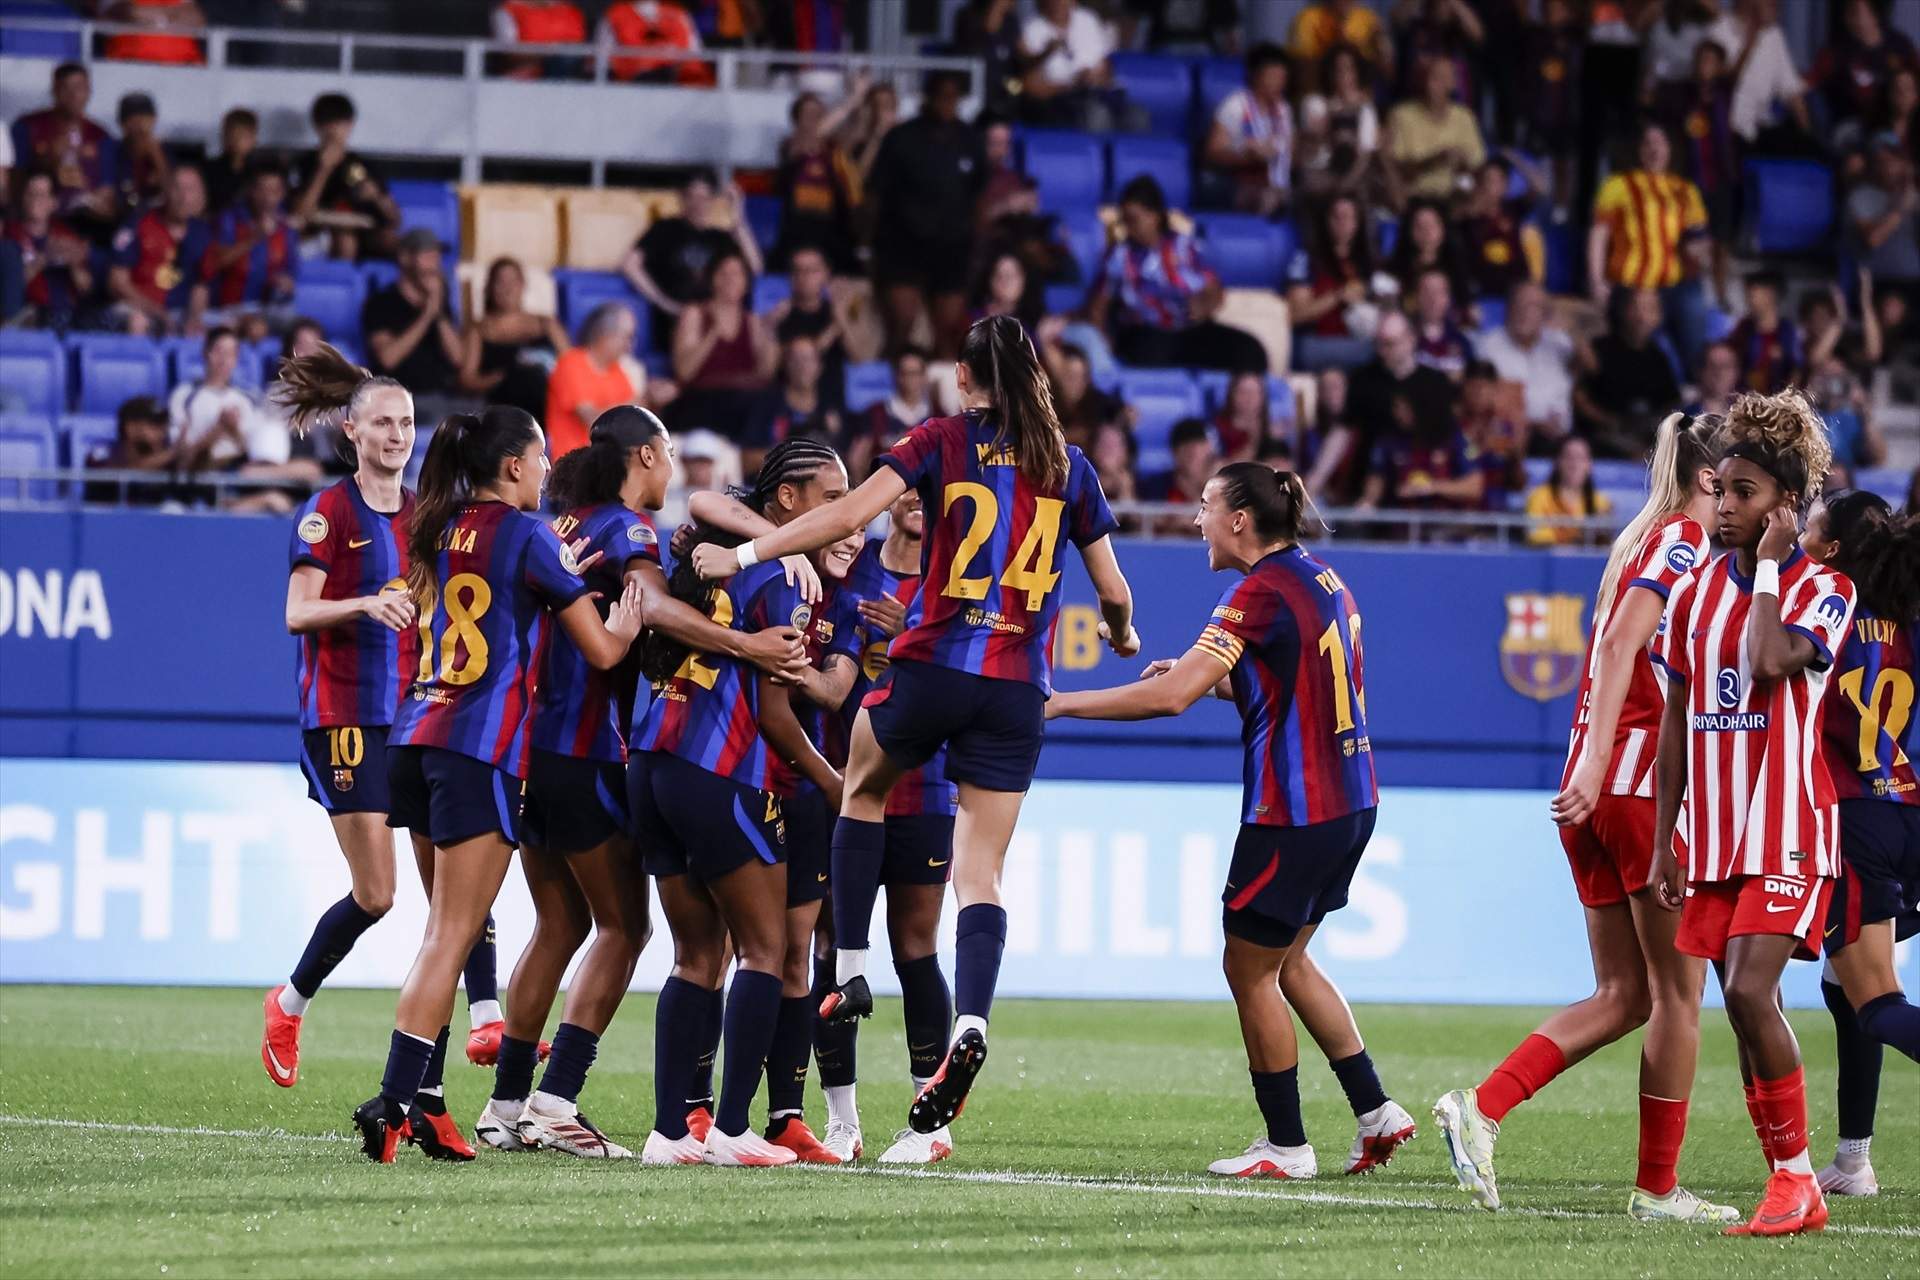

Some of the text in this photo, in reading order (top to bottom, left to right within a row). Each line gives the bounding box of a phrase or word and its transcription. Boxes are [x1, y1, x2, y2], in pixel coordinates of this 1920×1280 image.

[941, 481, 1066, 612] 24
[416, 572, 492, 686] 18
[326, 727, 364, 768] 10
[0, 803, 274, 942] GHT
[1764, 879, 1805, 900] DKV
